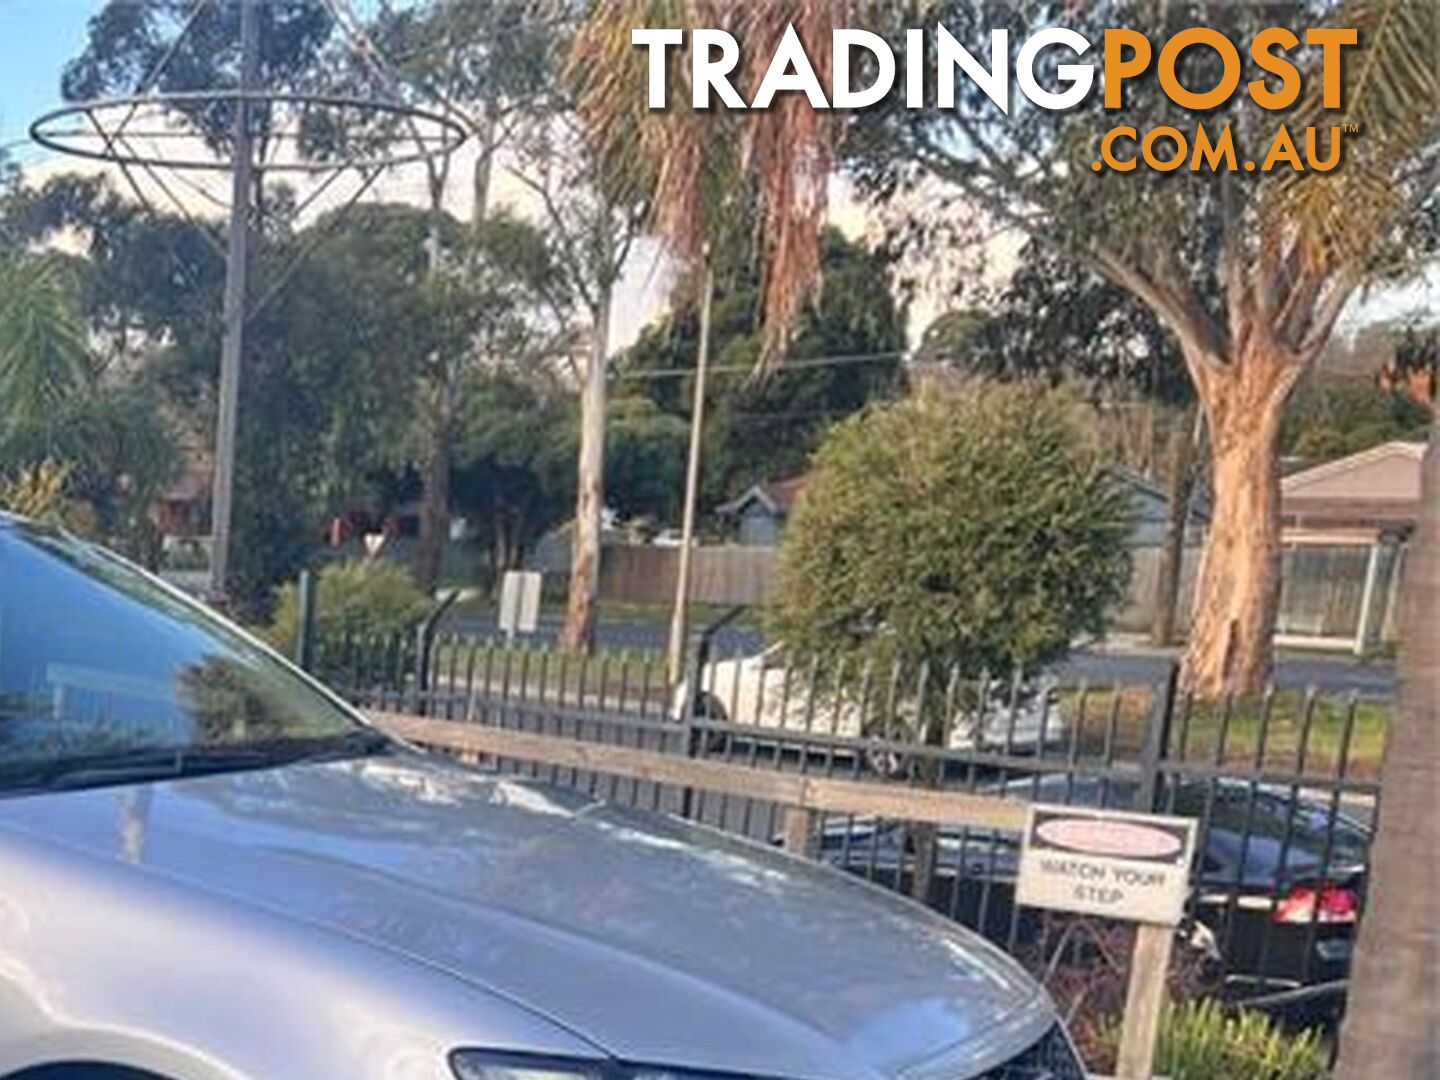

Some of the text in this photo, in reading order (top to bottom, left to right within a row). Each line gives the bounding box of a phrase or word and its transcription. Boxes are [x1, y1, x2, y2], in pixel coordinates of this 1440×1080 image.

[1040, 858, 1166, 887] WATCH YOUR
[1073, 884, 1125, 904] STEP
